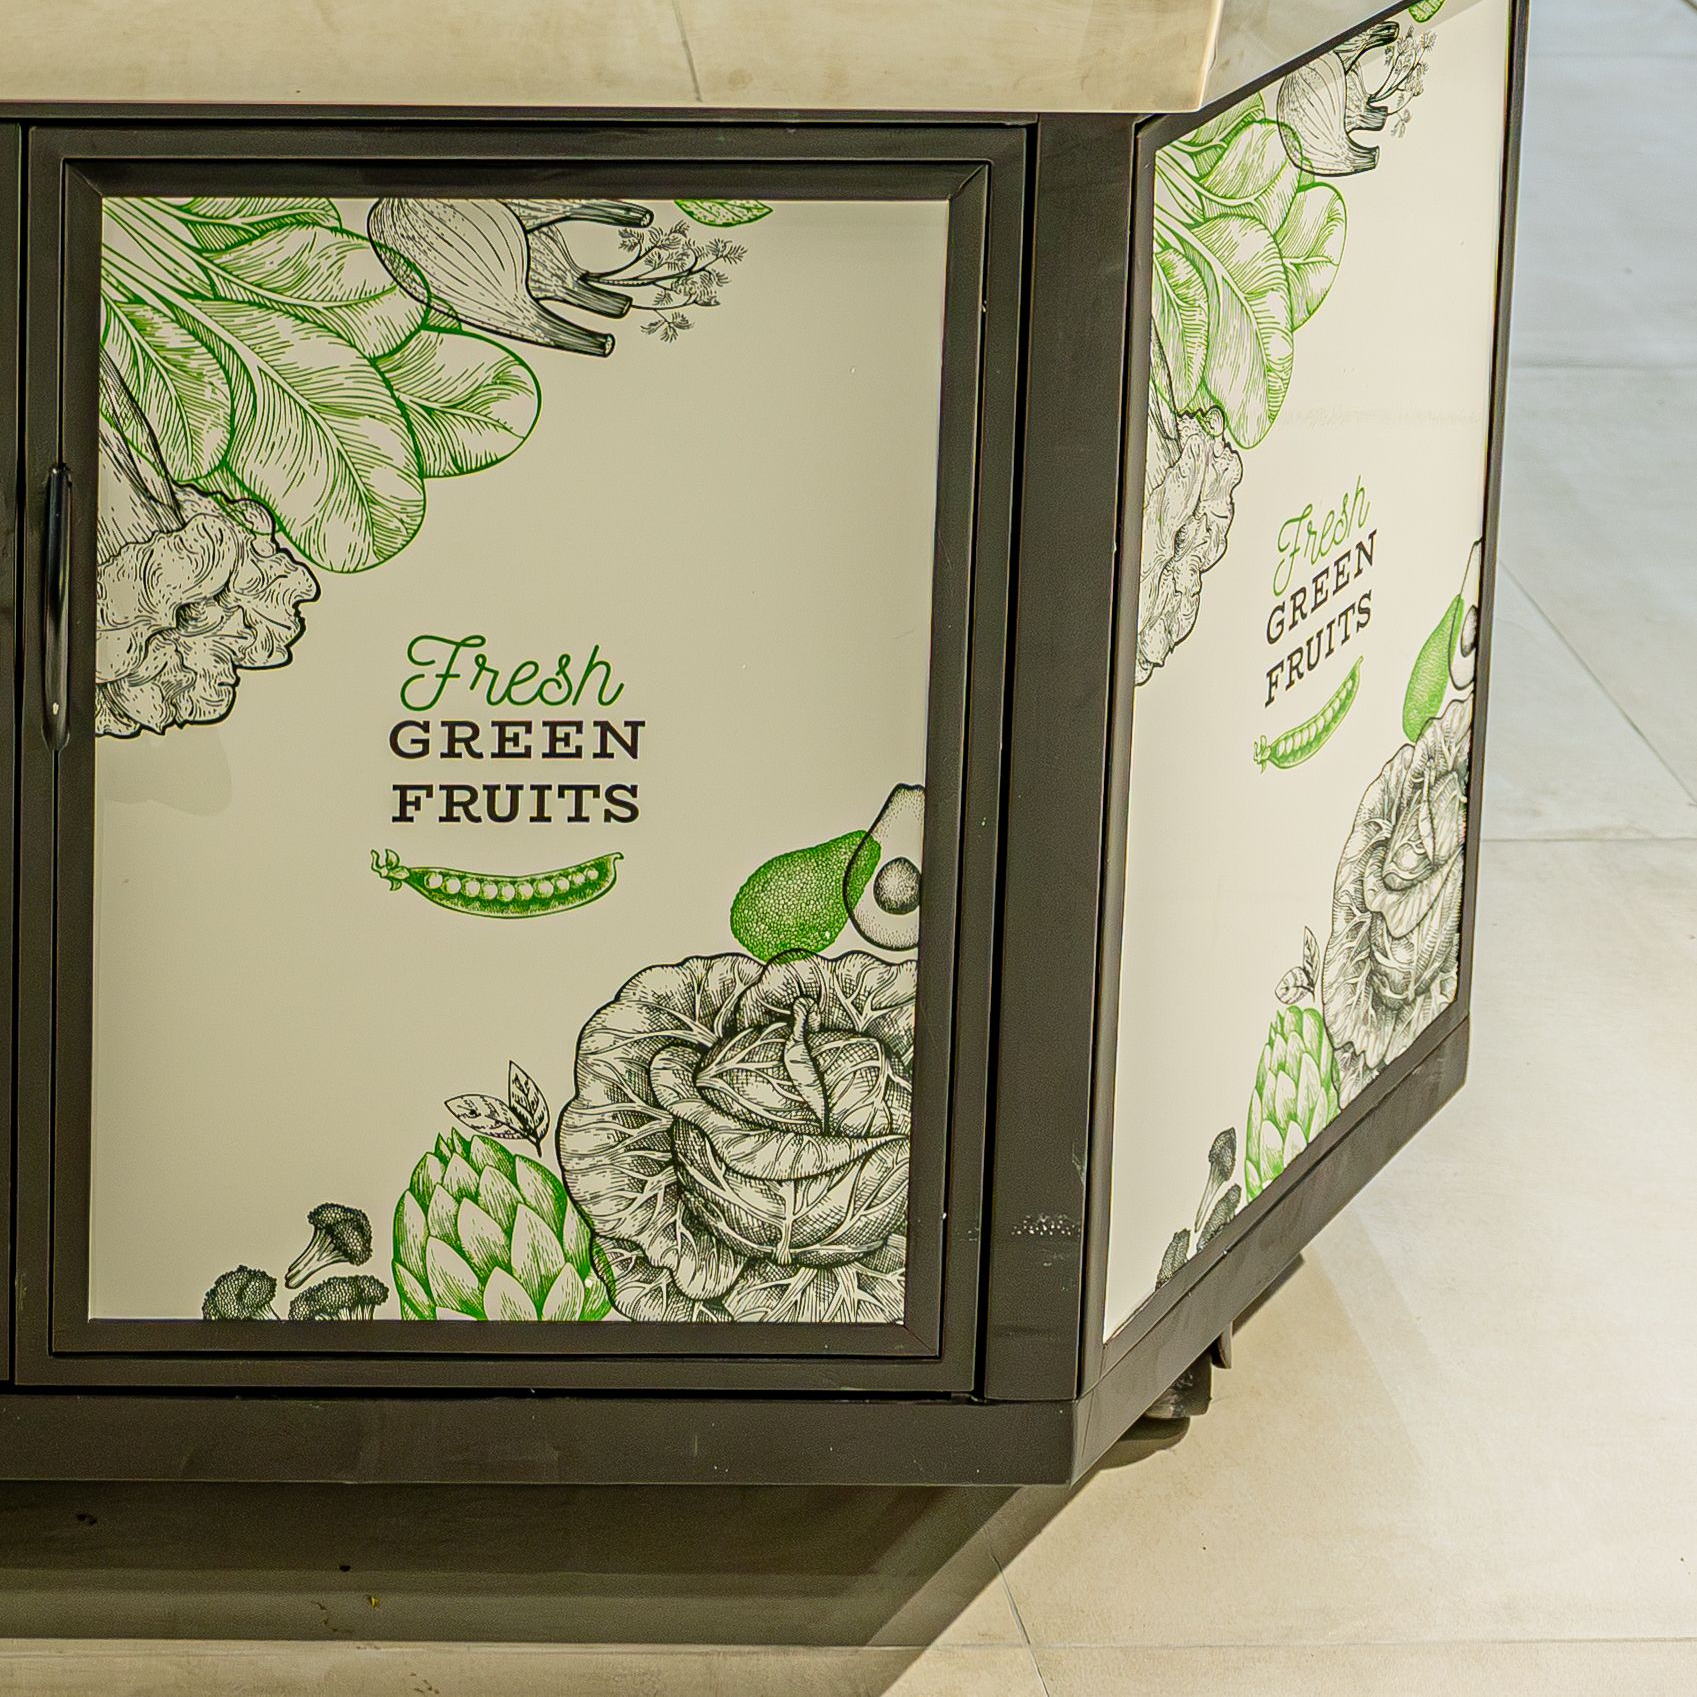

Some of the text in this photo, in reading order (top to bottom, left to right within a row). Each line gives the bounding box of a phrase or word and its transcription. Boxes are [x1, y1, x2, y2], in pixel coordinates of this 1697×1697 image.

[1272, 474, 1371, 597] Fresh
[1265, 529, 1378, 646] GREEN
[400, 634, 625, 712] Fresh
[1264, 590, 1373, 708] FRUITS
[389, 719, 646, 760] GREEN
[391, 783, 640, 824] FRUITS
